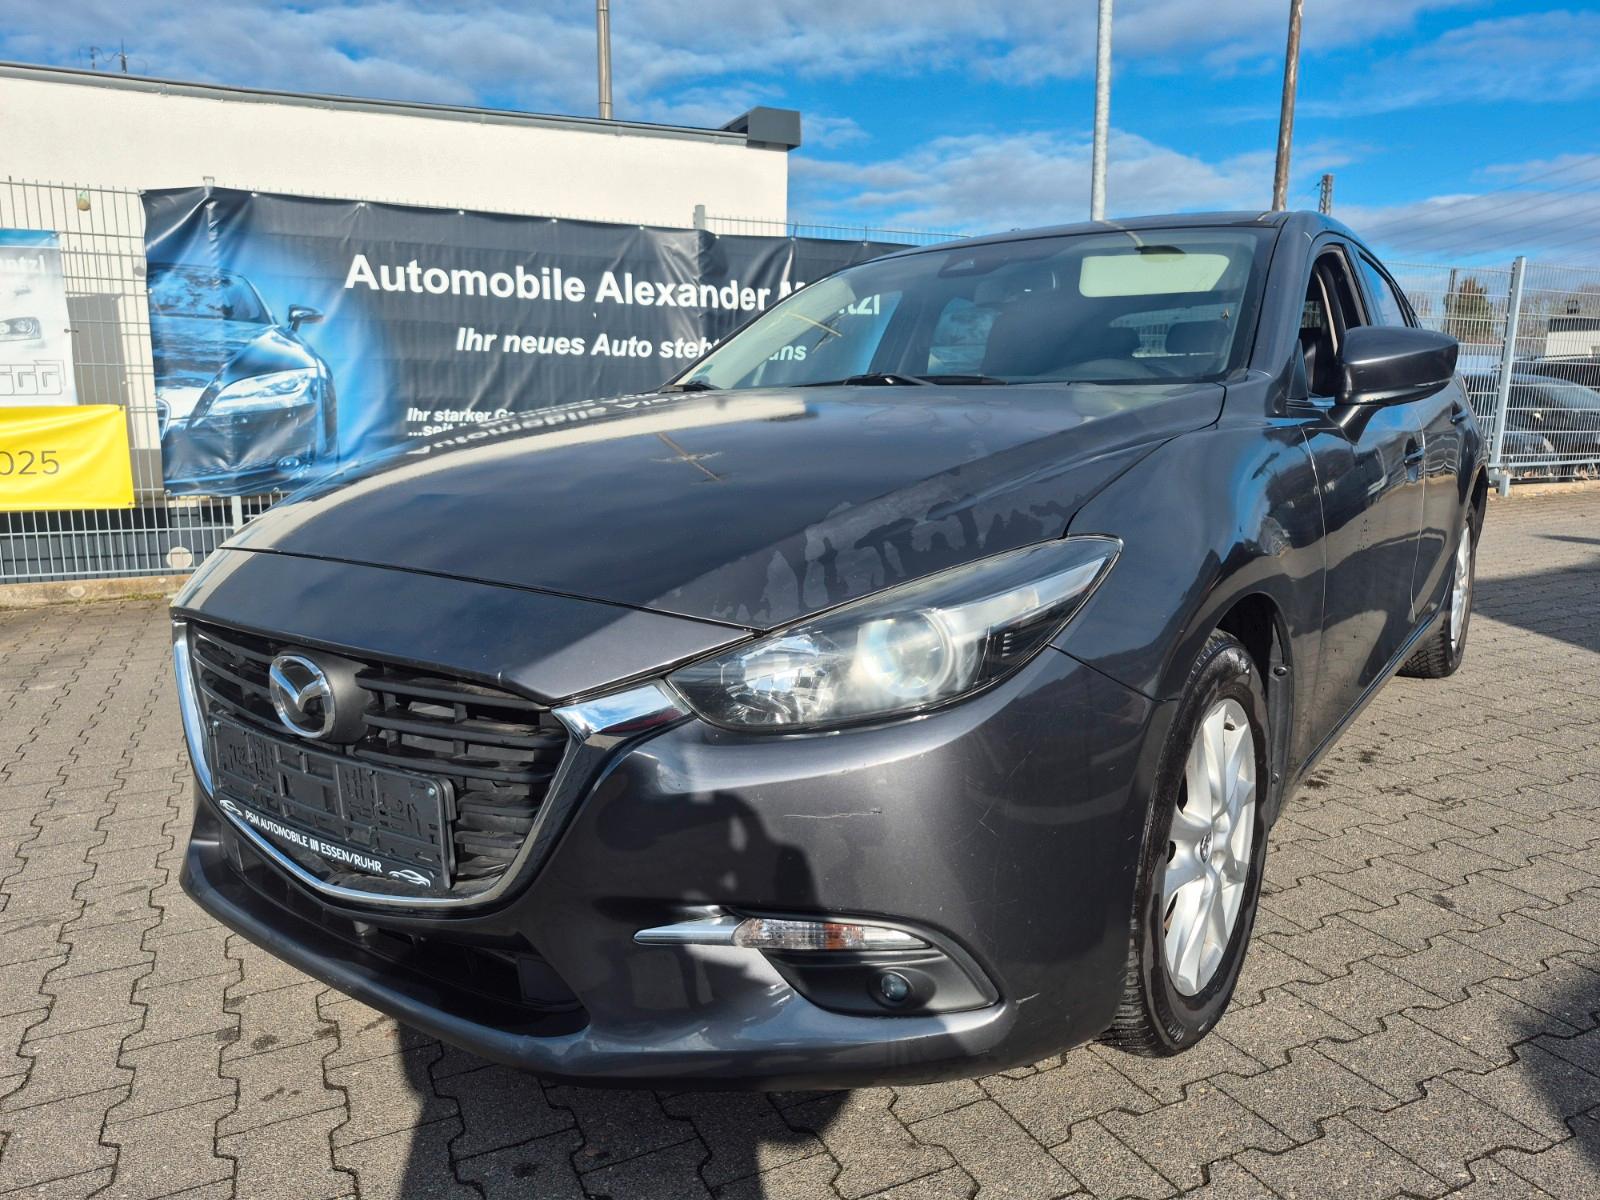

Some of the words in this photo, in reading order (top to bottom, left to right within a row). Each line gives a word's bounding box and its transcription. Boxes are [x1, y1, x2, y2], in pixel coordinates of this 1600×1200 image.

[344, 254, 586, 302] Automobile
[595, 271, 770, 311] Alexander
[456, 327, 497, 352] Ihr
[502, 334, 585, 355] neues
[590, 333, 653, 357] Auto
[407, 407, 431, 422] Ihr
[433, 407, 492, 423] starker
[261, 820, 308, 847] AUTOMOBILE
[320, 843, 382, 873] ESSEN/RUHR
